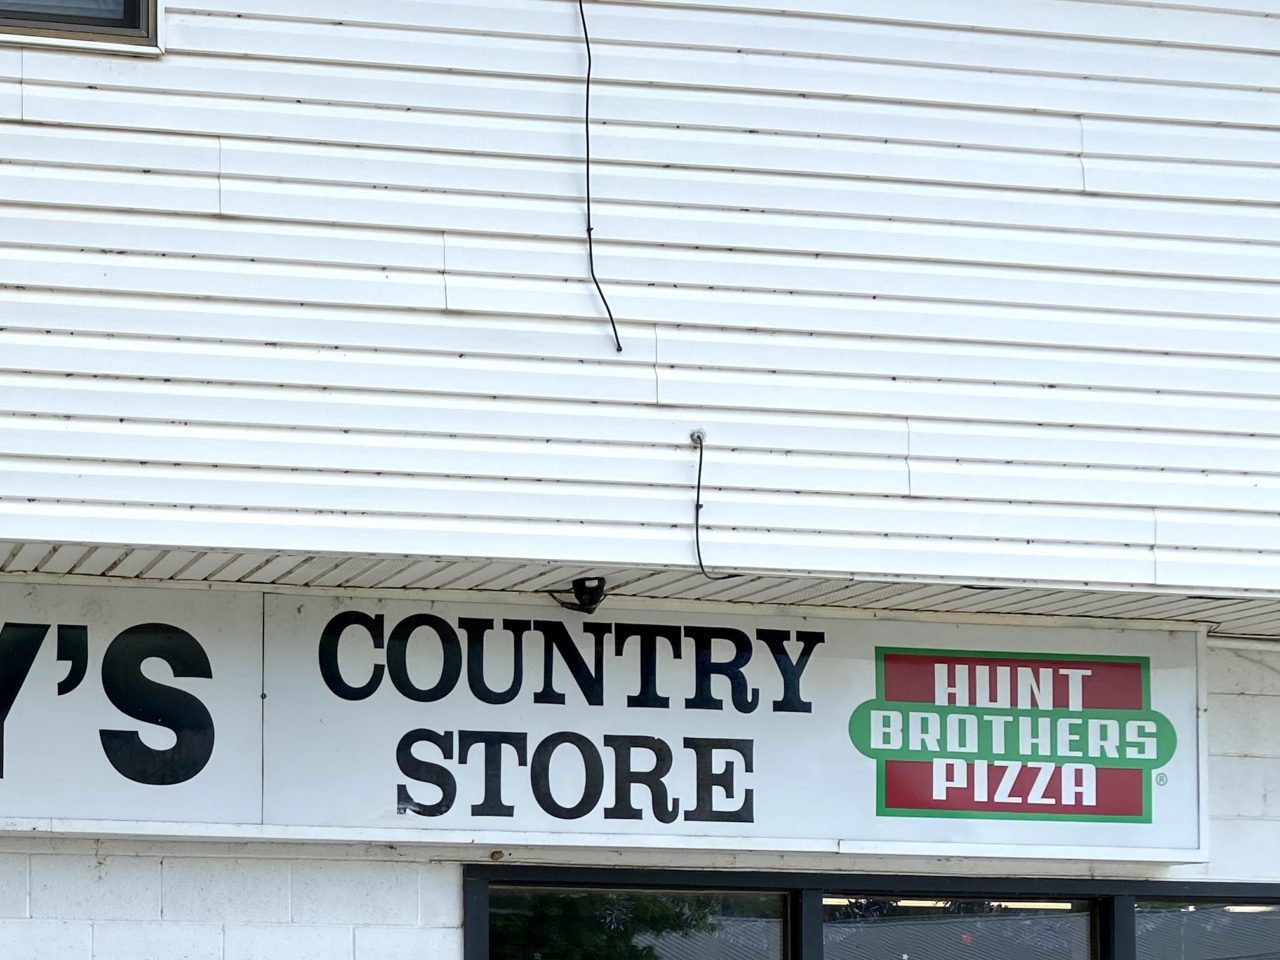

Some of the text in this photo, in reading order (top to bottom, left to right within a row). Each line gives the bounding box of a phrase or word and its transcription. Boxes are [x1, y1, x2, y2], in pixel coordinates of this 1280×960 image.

[318, 610, 826, 714] COUNTRY
[934, 663, 1092, 712] HUNT
[870, 710, 1158, 760] BROTHERS
[395, 728, 755, 824] STORE
[932, 757, 1097, 806] PIZZA
